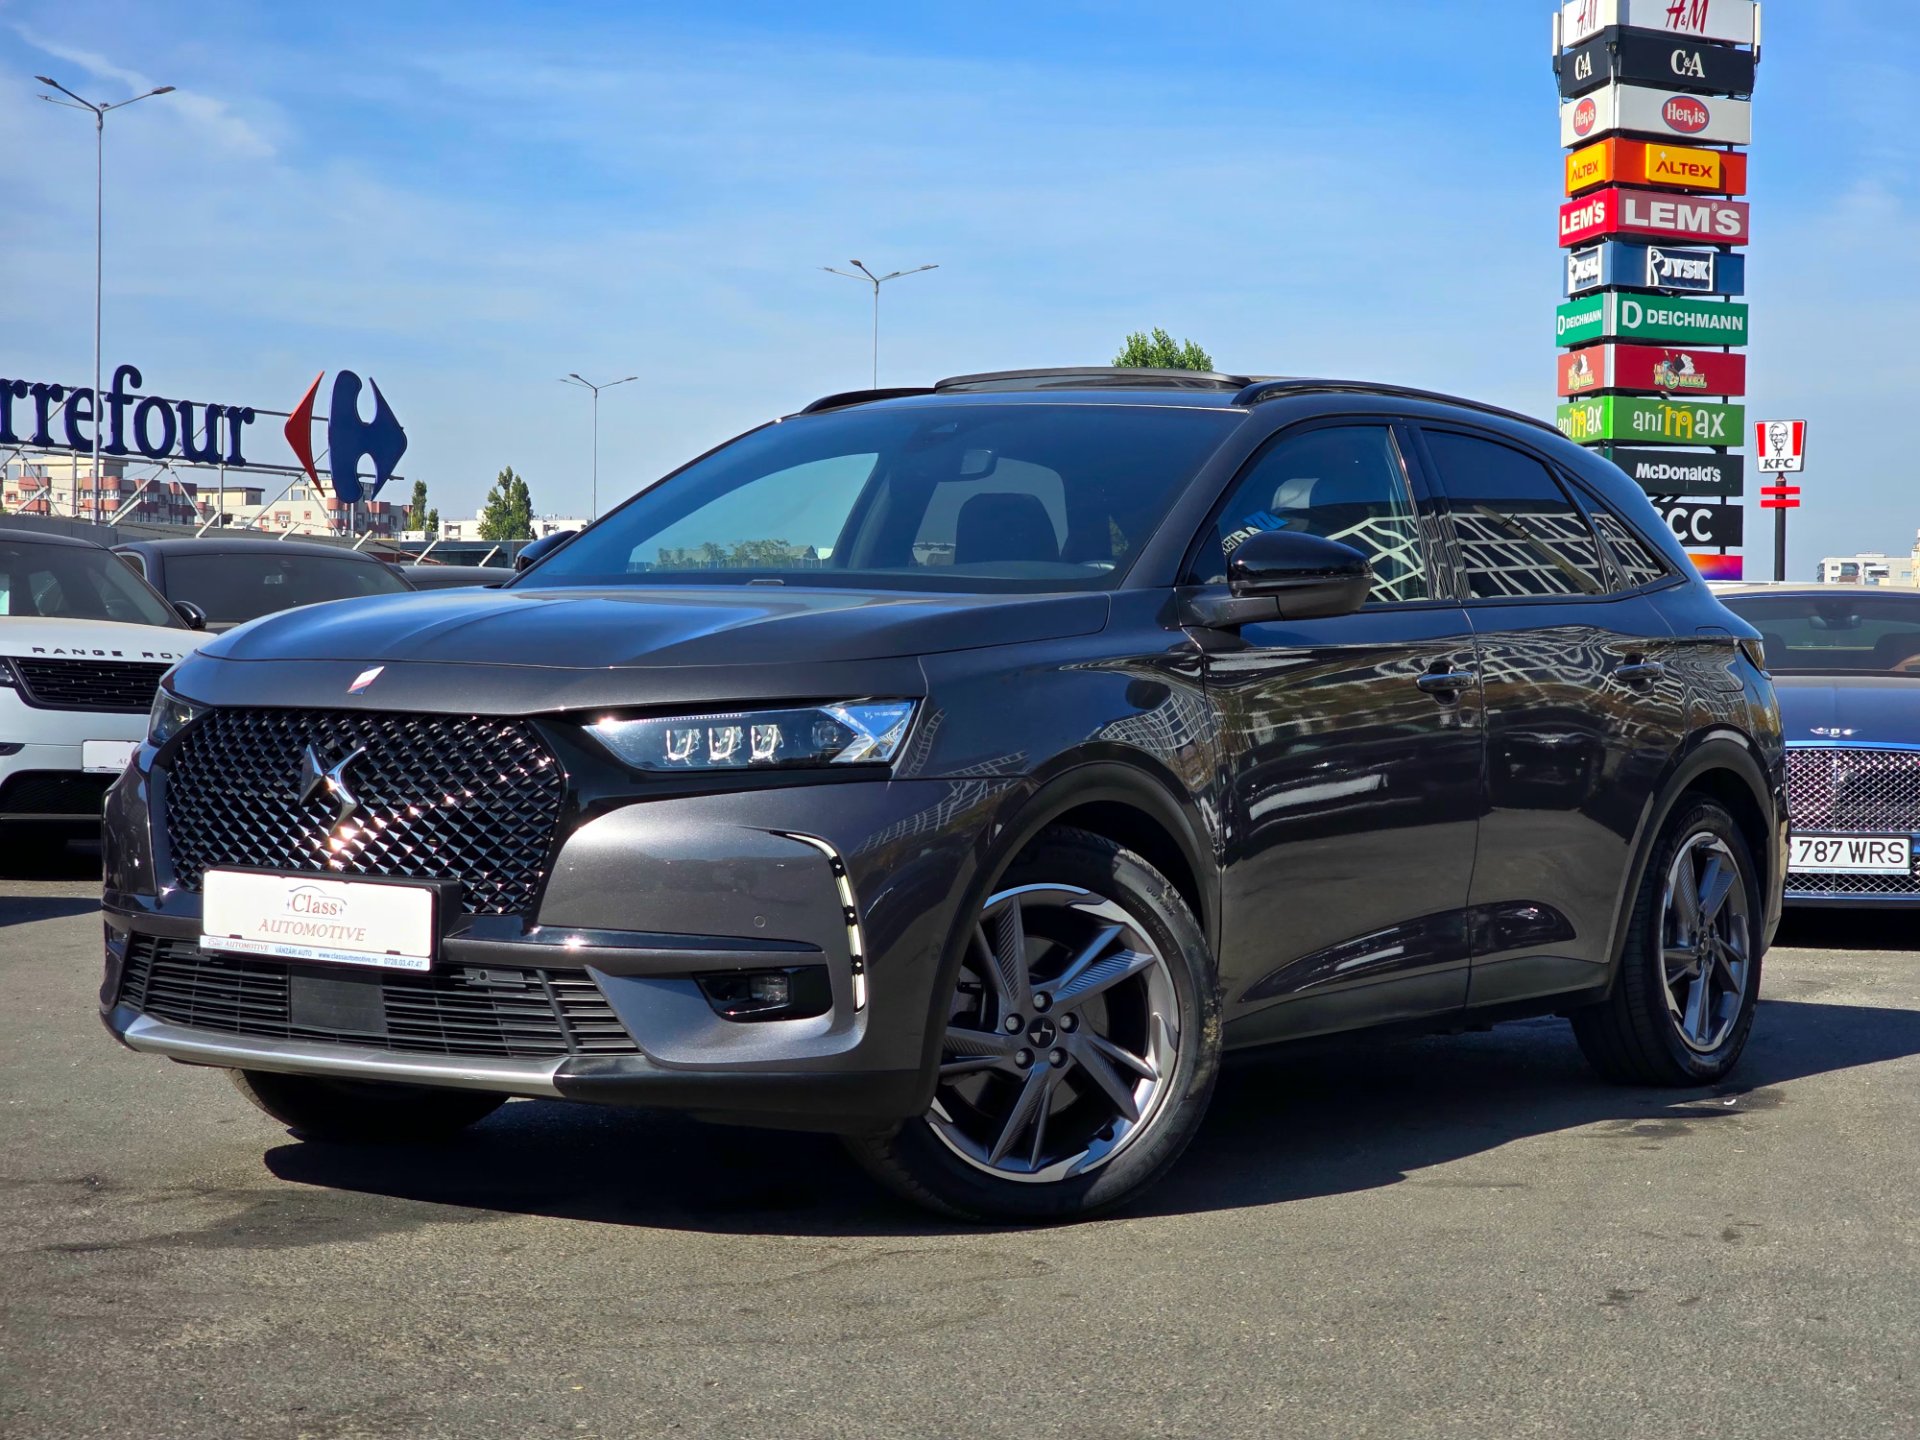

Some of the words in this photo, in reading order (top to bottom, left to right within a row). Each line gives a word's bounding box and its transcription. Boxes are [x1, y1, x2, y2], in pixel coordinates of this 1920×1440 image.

[1666, 0, 1708, 34] H&M
[1575, 51, 1592, 80] C&A
[1671, 49, 1705, 78] C&A
[1575, 105, 1595, 127] Hervis
[1667, 103, 1706, 126] Hervis
[1561, 201, 1605, 236] LEM'S
[1661, 257, 1709, 280] JYSK
[1566, 309, 1602, 329] DEICHMANN
[1647, 309, 1743, 331] DEICHMANN
[1558, 404, 1603, 438] animax
[1632, 404, 1726, 440] animax
[1636, 462, 1721, 483] McDonald's
[1763, 458, 1794, 470] KFC
[1652, 506, 1713, 542] CC
[32, 647, 123, 657] RANGE
[1799, 840, 1843, 863] 787
[1848, 841, 1904, 864] WRS
[292, 893, 338, 915] Class
[258, 918, 366, 942] AUTOMOTIVE
